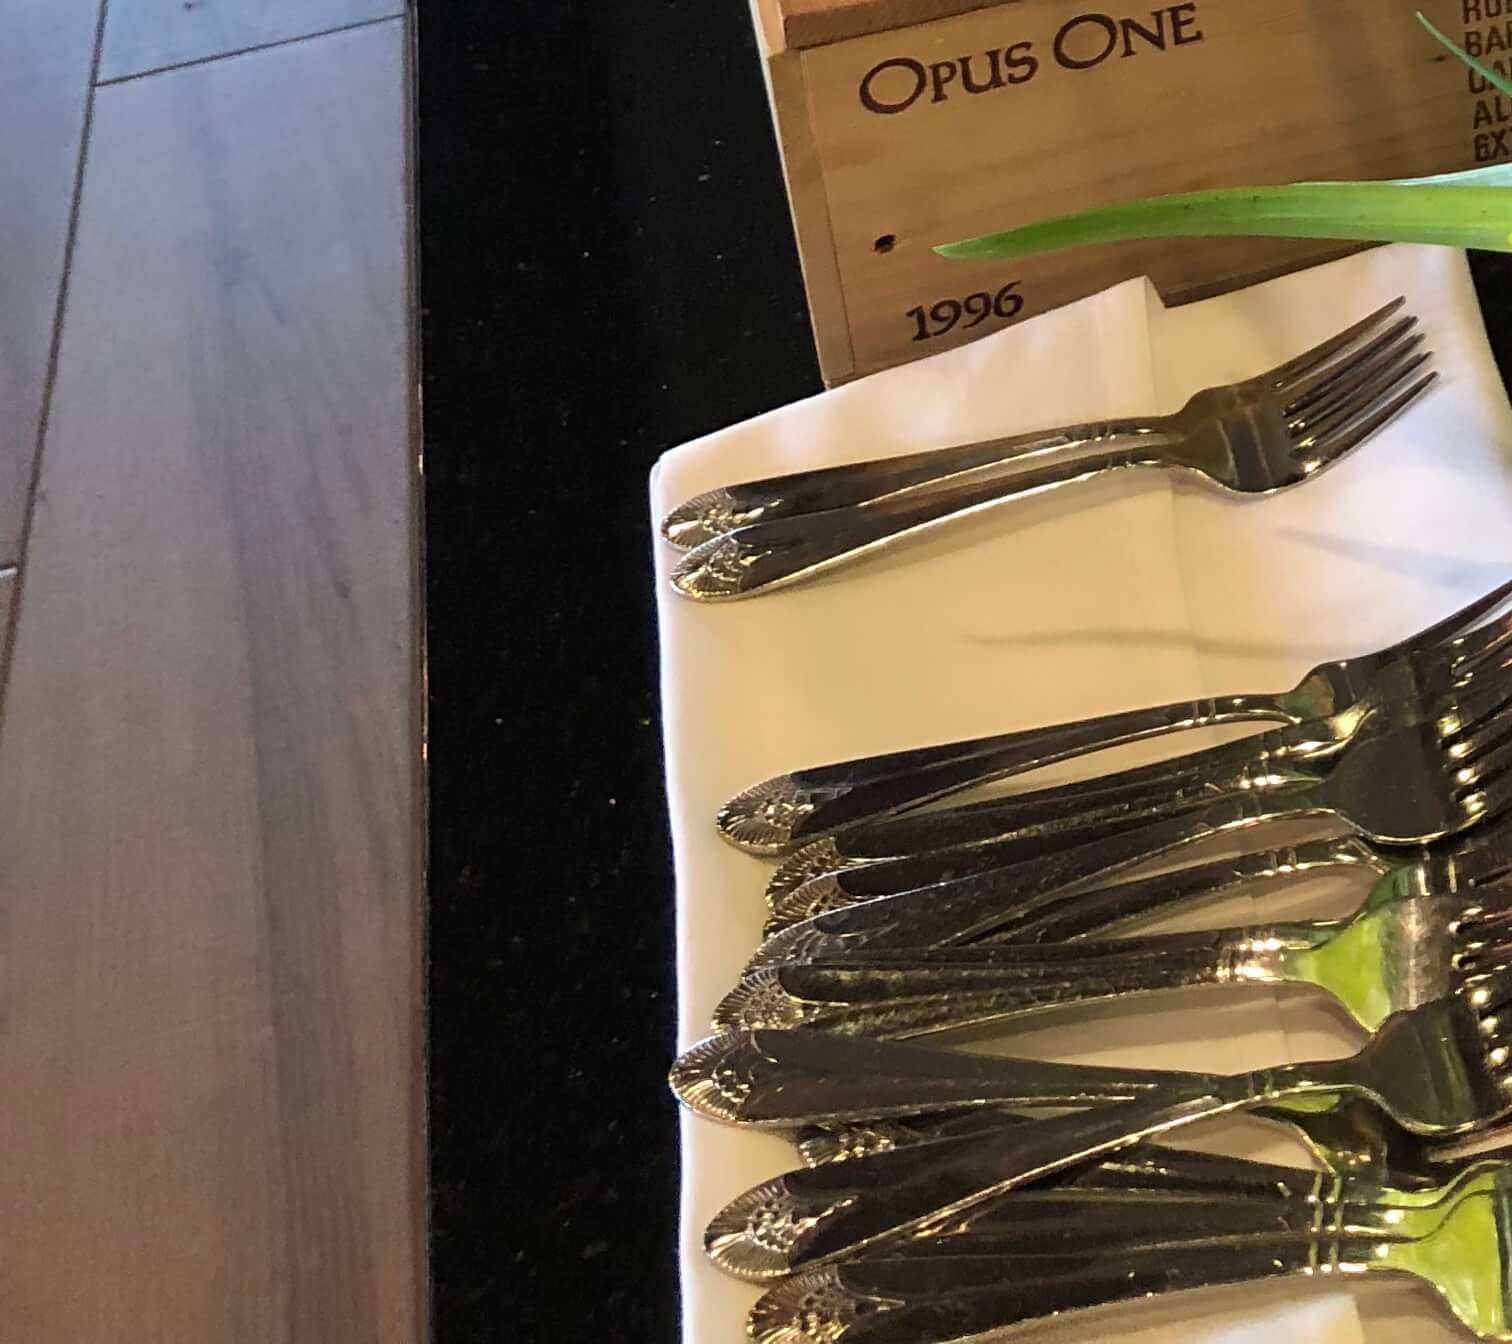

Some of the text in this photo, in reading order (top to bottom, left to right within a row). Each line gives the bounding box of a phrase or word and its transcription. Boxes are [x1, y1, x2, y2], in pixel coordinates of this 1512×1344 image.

[859, 2, 1203, 114] OPUS ONE
[906, 280, 1023, 341] 1996
